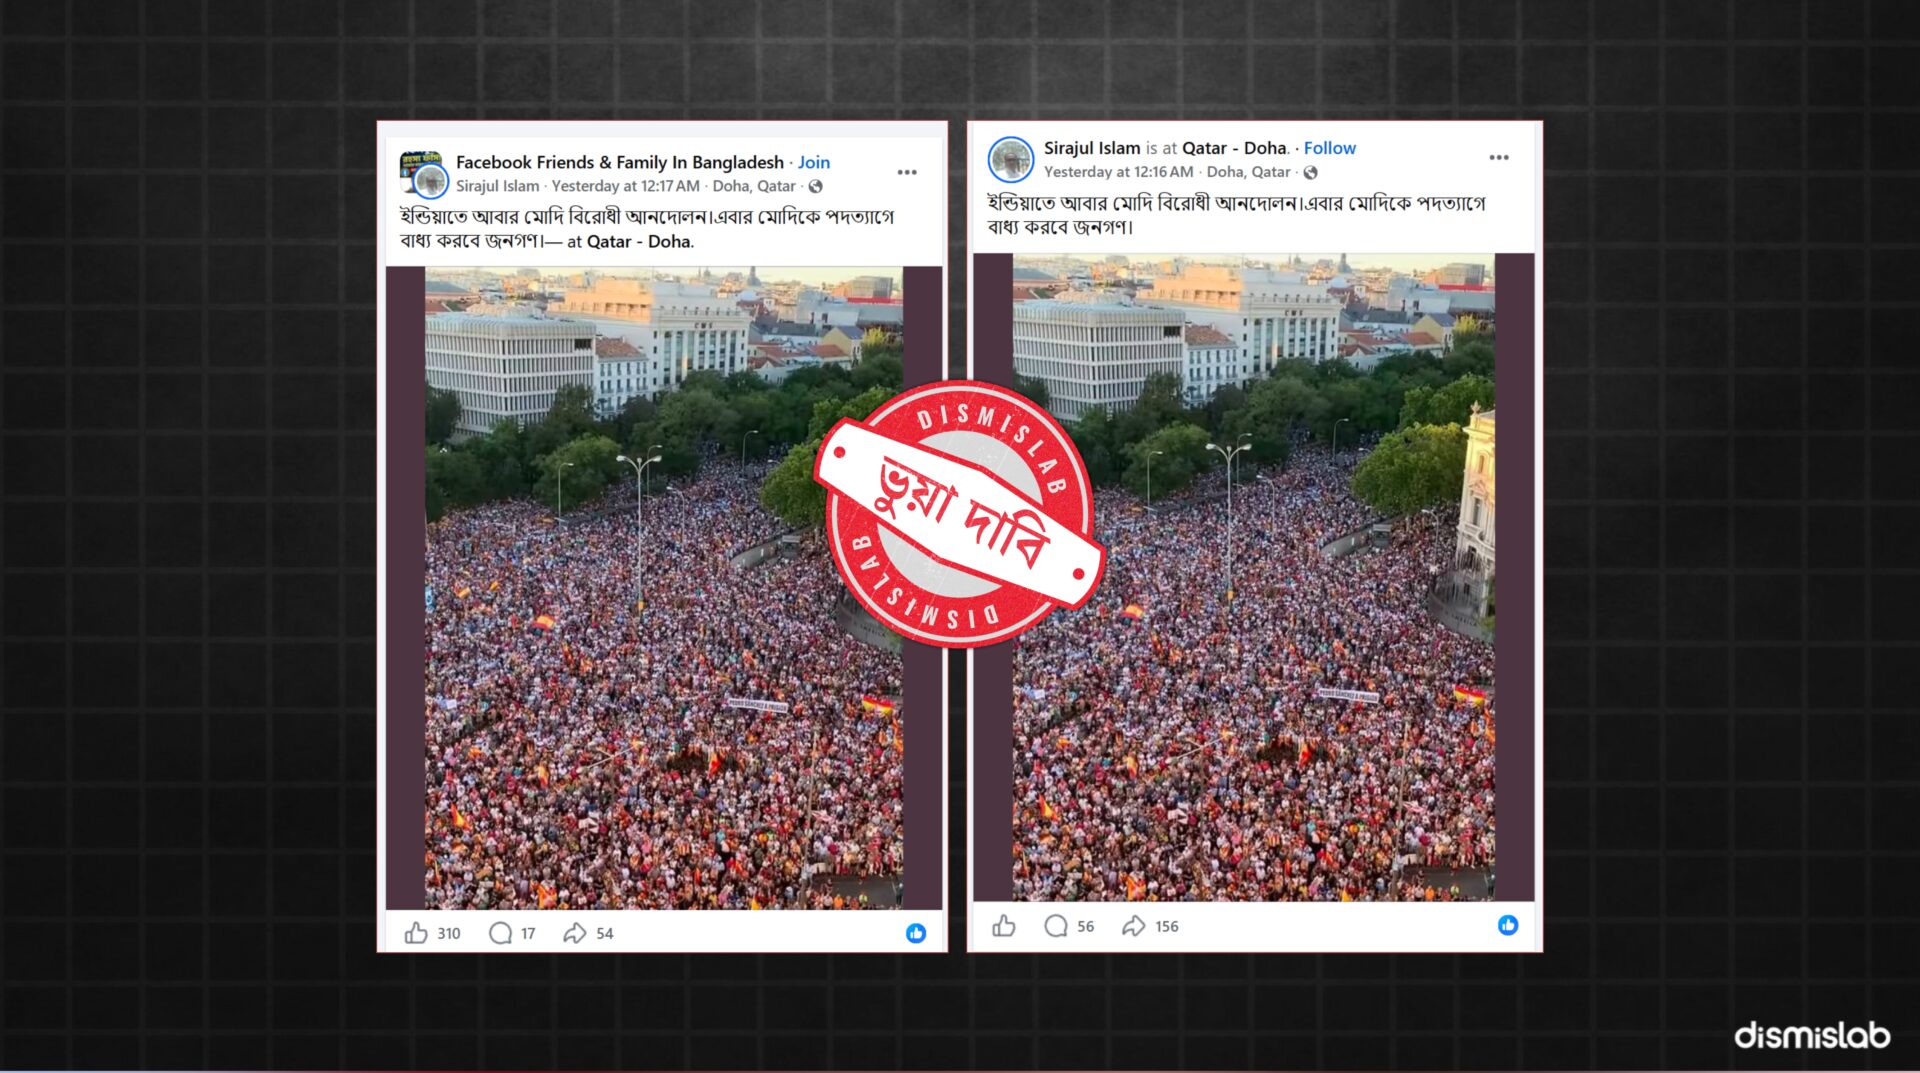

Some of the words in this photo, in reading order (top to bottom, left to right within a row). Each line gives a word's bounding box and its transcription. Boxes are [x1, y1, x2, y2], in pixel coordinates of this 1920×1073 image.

[1045, 140, 1094, 159] Sirajul
[1099, 140, 1142, 156] Islam
[1147, 140, 1158, 156] is
[1163, 142, 1178, 156] at
[1182, 140, 1229, 157] Qatar
[1245, 140, 1292, 156] Doha.
[1304, 140, 1358, 156] Follow
[456, 154, 533, 170] Facebook
[537, 154, 595, 170] Friends
[599, 154, 613, 170] &
[617, 154, 669, 174] Family
[673, 154, 688, 170] In
[693, 154, 785, 175] Bangladesh
[798, 154, 831, 170] Join
[1044, 165, 1113, 181] Yesterday
[1117, 166, 1131, 179] at
[1134, 165, 1167, 179] 12:16
[1170, 166, 1194, 179] AM
[1207, 165, 1248, 181] Doha,
[1252, 165, 1292, 180] Qatar
[456, 179, 499, 196] Sirajul
[503, 179, 540, 193] Islam
[552, 179, 621, 196] Yesterday
[624, 180, 638, 193] at
[641, 179, 674, 193] 12:17
[676, 179, 701, 193] AM
[713, 179, 753, 195] Doha,
[757, 179, 797, 194] Qatar
[1060, 196, 1108, 212] আবার
[1113, 191, 1153, 212] মোদি
[1158, 191, 1210, 212] বিরোধী
[1349, 191, 1412, 212] মোদিকে
[1416, 196, 1486, 212] পদত্যাগে
[471, 210, 520, 225] আবার
[524, 204, 565, 225] মোদি
[569, 204, 621, 225] বিরোধী
[758, 204, 821, 225] মোদিকে
[825, 209, 895, 225] পদত্যাগে
[987, 220, 1020, 235] বাধ্য
[1023, 220, 1069, 235] করবে
[1072, 220, 1133, 236] জনগণ।
[400, 233, 432, 249] বাধ্য
[435, 234, 481, 249] করবে
[567, 235, 583, 249] at
[587, 234, 633, 251] Qatar
[648, 233, 695, 249] Doha.
[437, 926, 461, 940] 310
[521, 926, 537, 940] 17
[596, 926, 615, 940] 54
[1077, 920, 1095, 933] 56
[1156, 920, 1179, 933] 156
